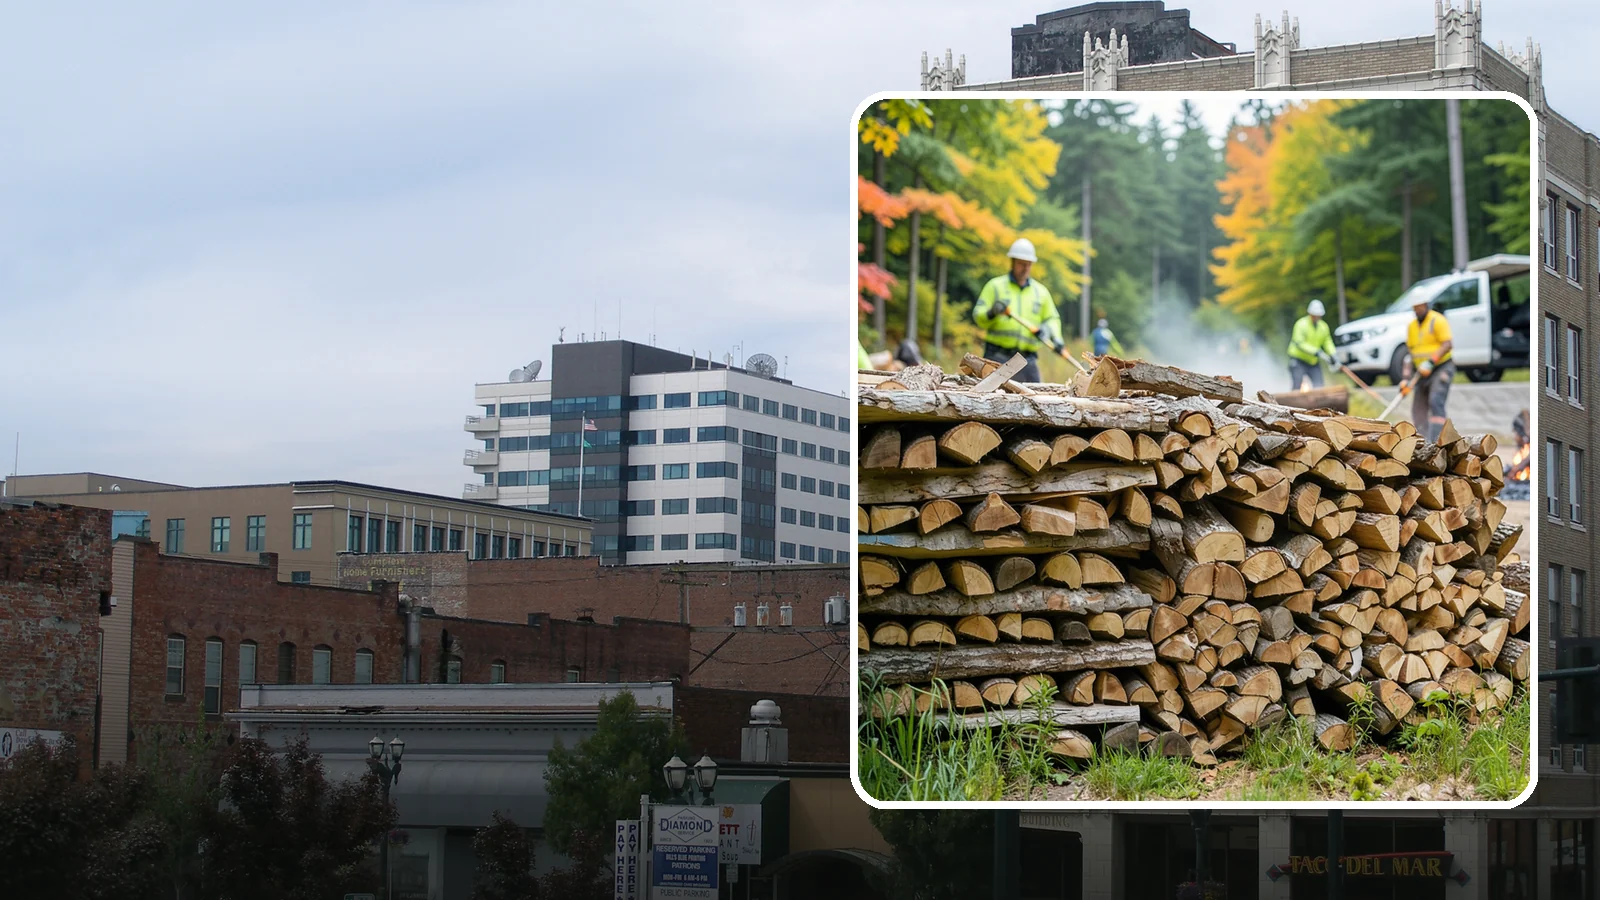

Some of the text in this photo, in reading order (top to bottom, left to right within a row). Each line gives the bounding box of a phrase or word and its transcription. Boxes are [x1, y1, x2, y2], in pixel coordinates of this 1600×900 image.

[370, 566, 426, 576] Furnishers
[660, 818, 713, 832] DIAMOND
[1022, 815, 1069, 828] BUILDING
[656, 845, 716, 854] RESERVED PARKING
[721, 851, 739, 863] Soup
[671, 862, 701, 870] PATRONS
[1289, 855, 1442, 877] TAC DEL MAR
[660, 888, 708, 899] PUBLIC PARKING
